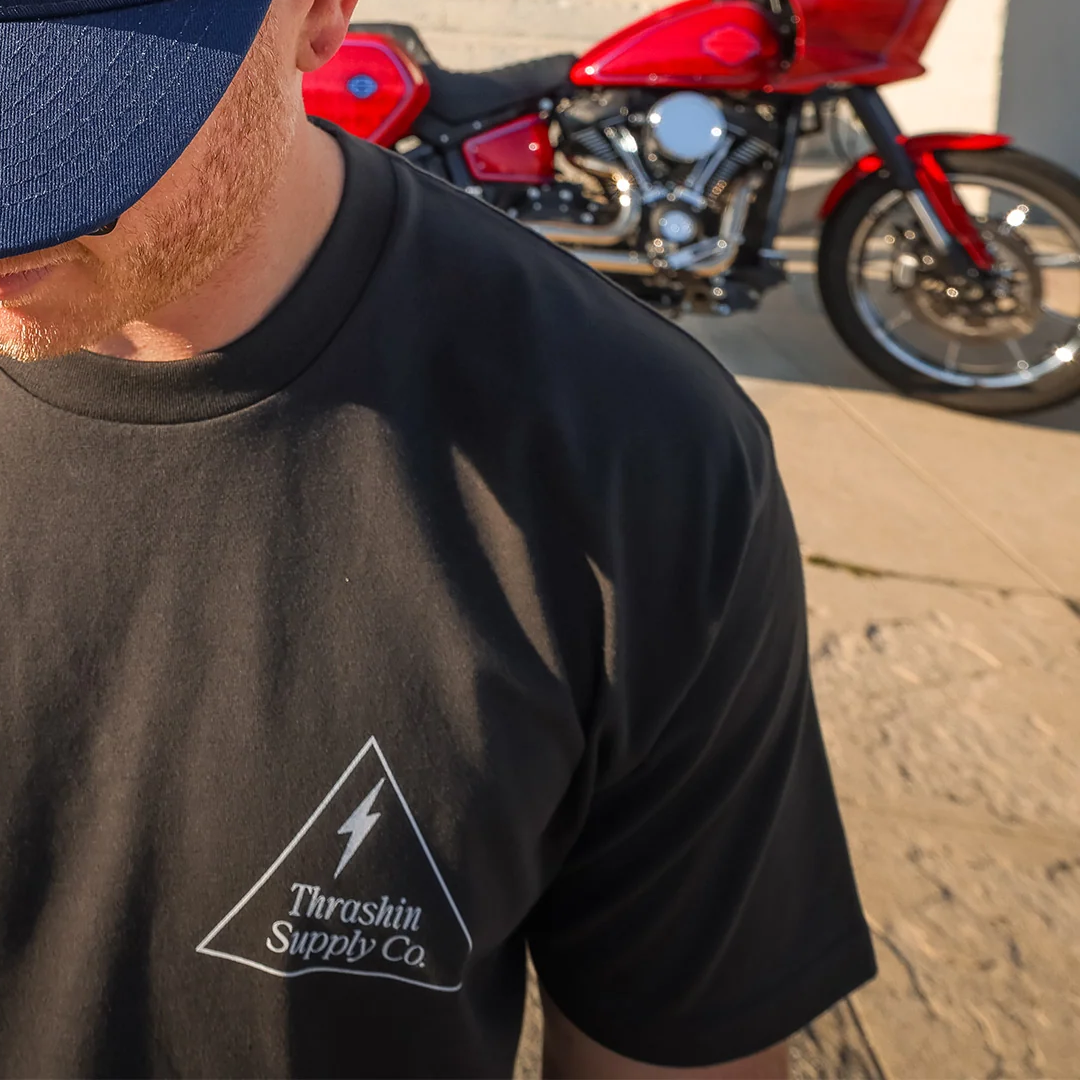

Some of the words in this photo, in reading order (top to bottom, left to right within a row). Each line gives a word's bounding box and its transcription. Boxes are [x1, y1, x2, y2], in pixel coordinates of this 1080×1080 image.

[288, 882, 422, 931] Thrashin
[266, 920, 376, 963] Supply
[382, 935, 426, 967] Co.
